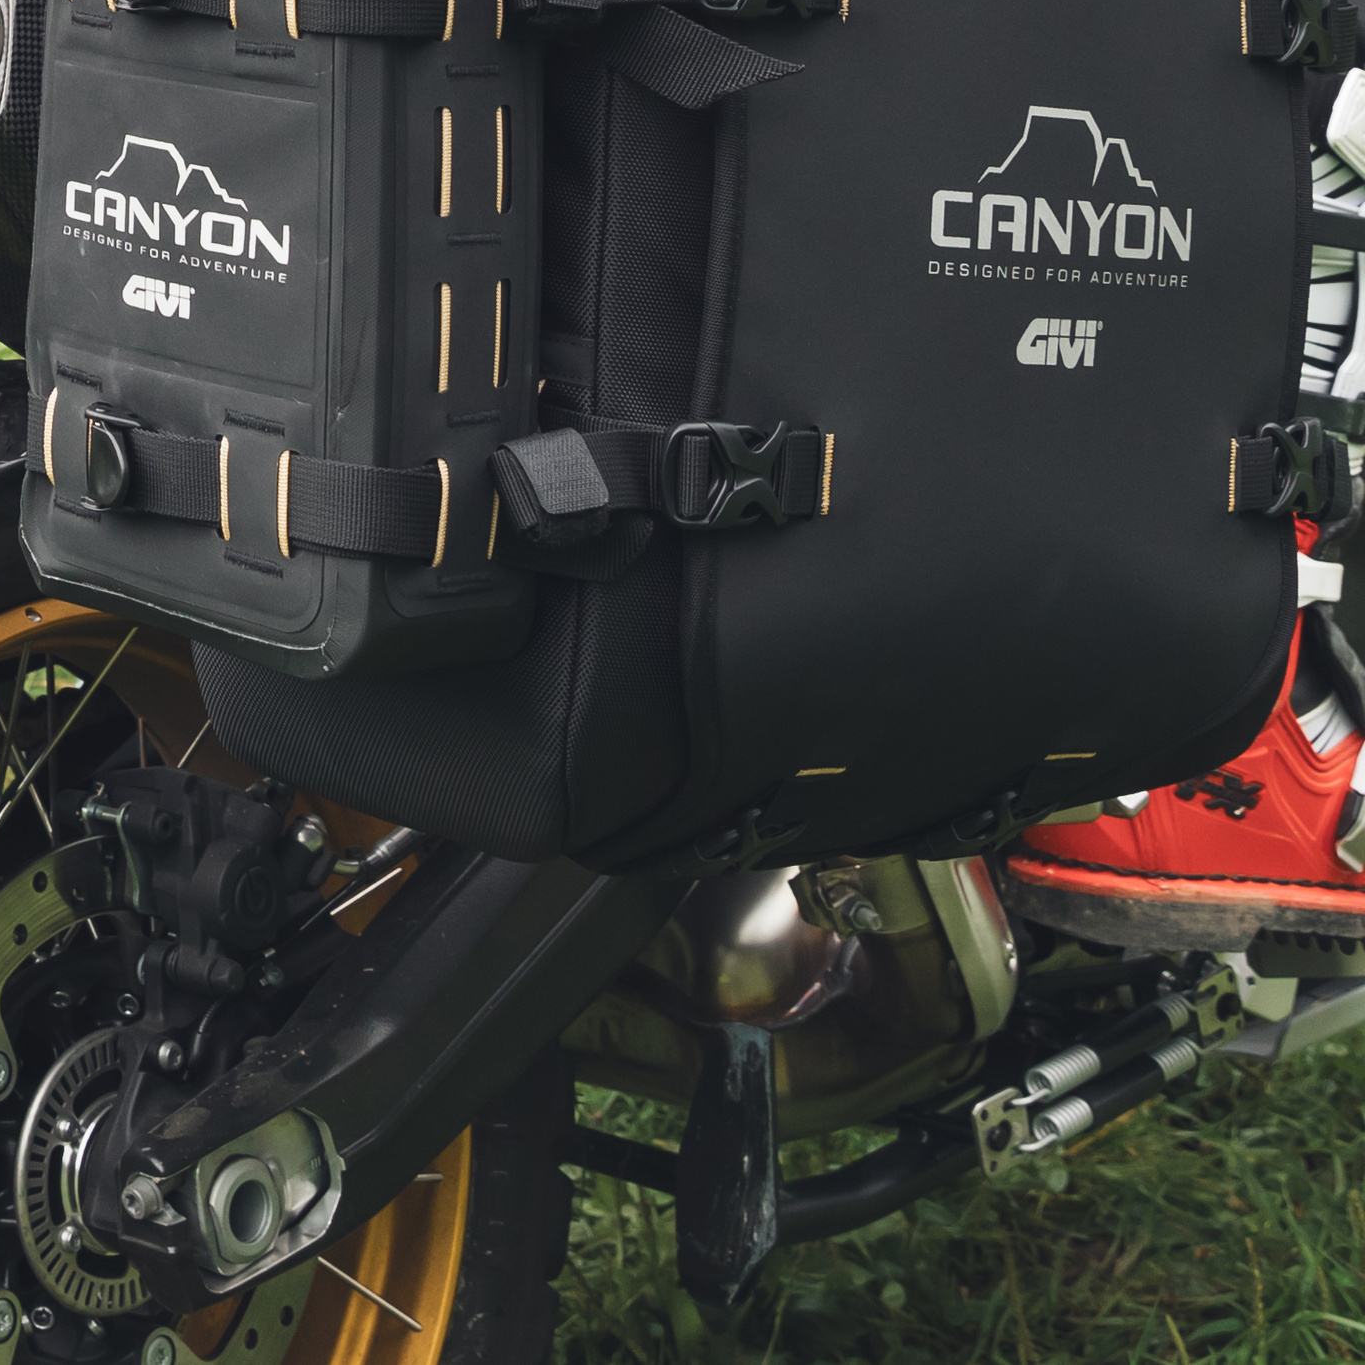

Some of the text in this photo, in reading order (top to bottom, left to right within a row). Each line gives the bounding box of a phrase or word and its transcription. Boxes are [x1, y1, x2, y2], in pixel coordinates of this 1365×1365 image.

[65, 180, 290, 266] CANYON
[930, 189, 1193, 262] CANYON
[63, 225, 288, 284] DESIGNED FOR ADVENTURE
[928, 260, 1189, 288] DESIGNED FOR ADVENTURE
[122, 274, 195, 320] GIVI
[1016, 317, 1103, 369] GIVI
